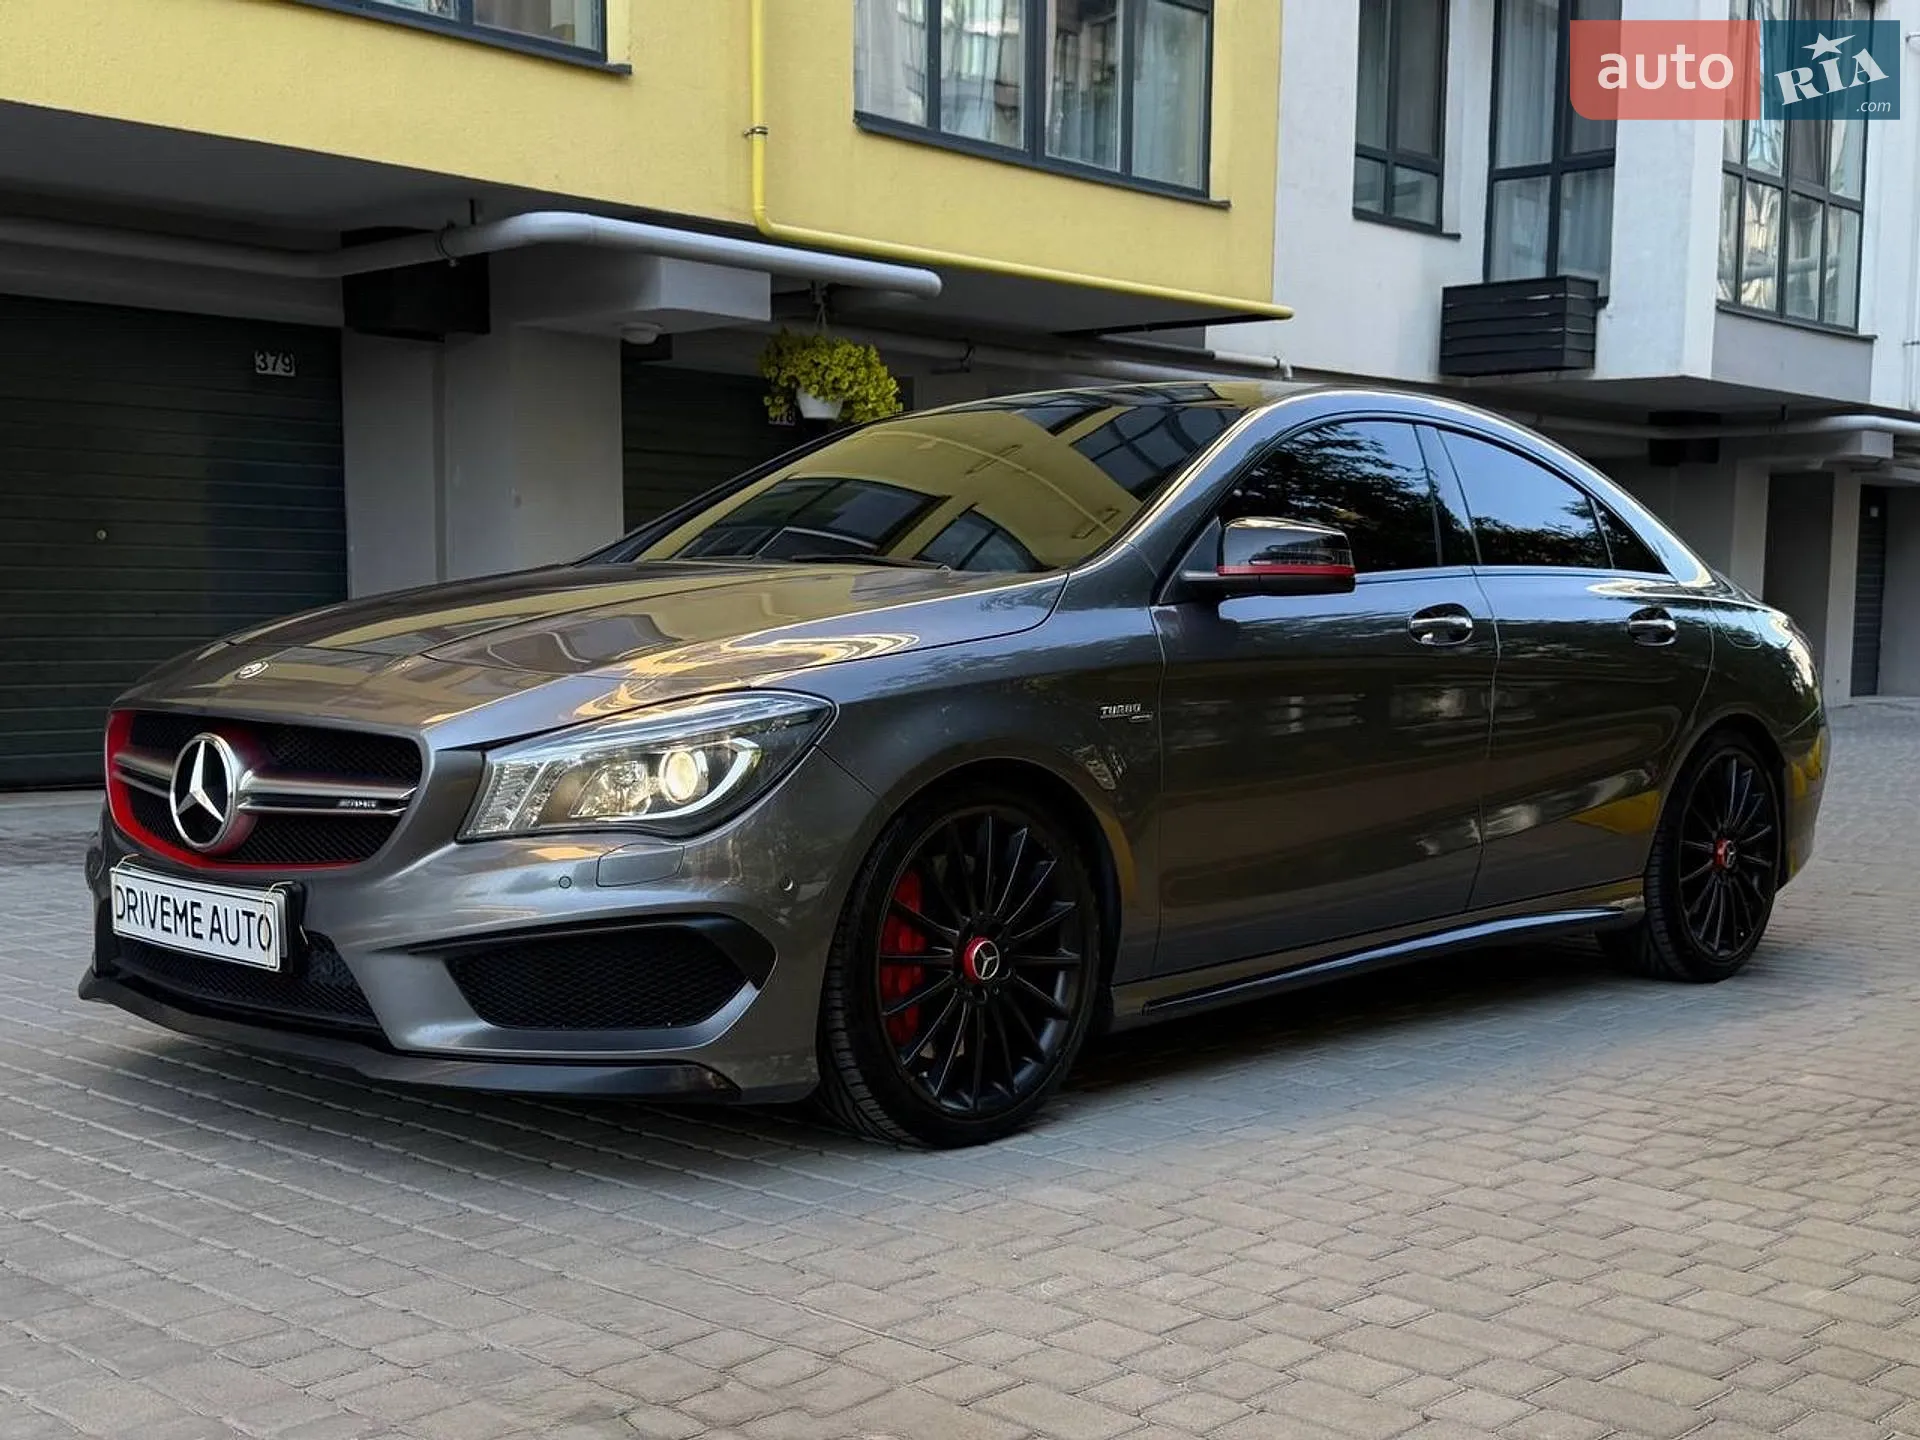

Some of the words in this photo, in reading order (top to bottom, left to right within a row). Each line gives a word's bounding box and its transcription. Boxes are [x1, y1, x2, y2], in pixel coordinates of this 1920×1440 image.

[257, 351, 293, 374] 379
[115, 884, 204, 940] DRIVEME
[209, 905, 272, 951] AUTO
